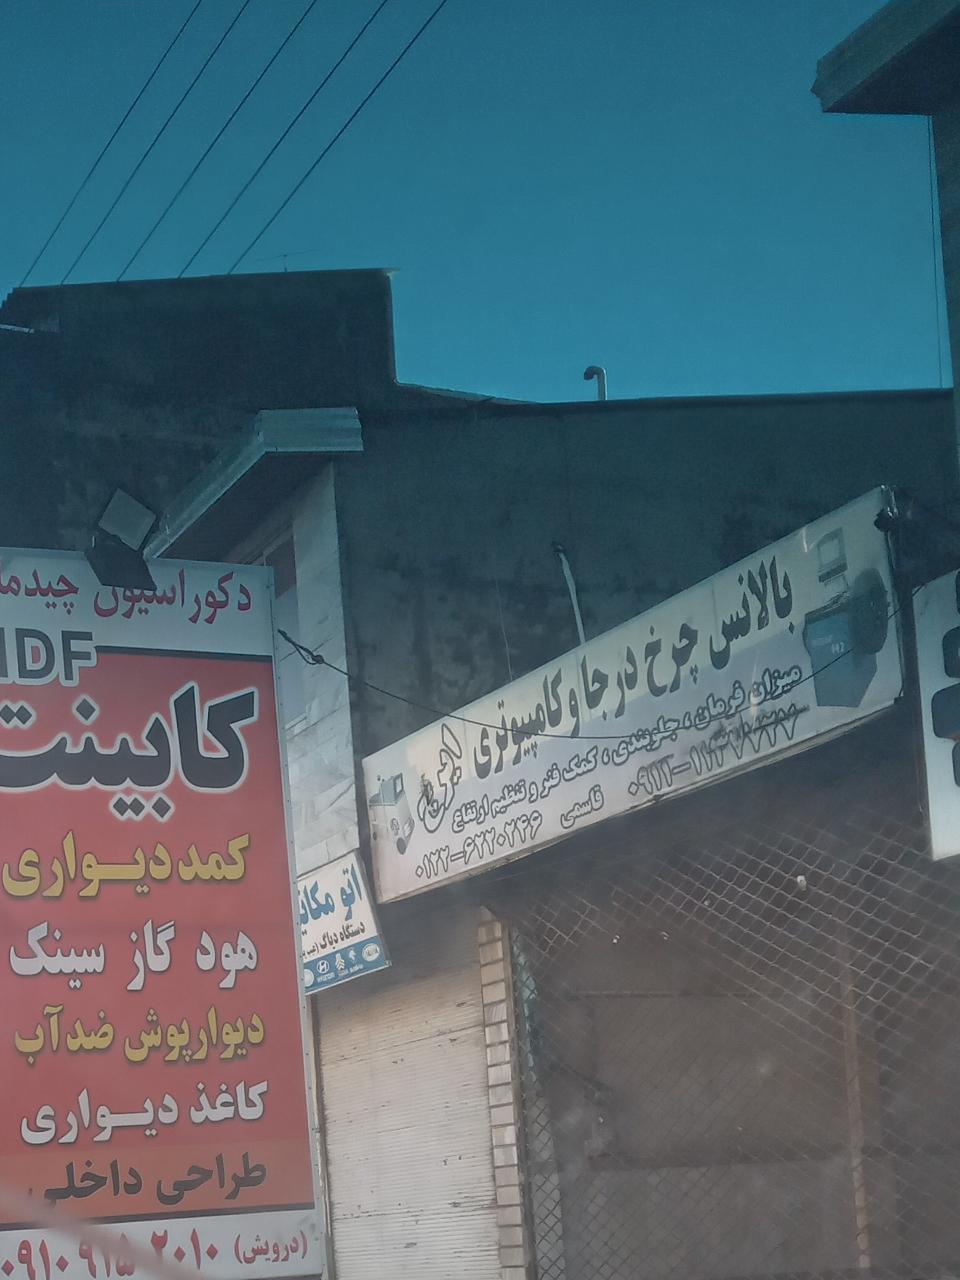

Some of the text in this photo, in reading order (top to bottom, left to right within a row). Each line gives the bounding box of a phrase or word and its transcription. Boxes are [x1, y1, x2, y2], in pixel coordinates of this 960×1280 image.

[709, 555, 795, 670] بالانس
[644, 614, 700, 697] چرخ
[540, 763, 562, 799] فنر
[562, 746, 598, 781] کمک
[561, 784, 604, 829] قاسمی
[1, 830, 252, 898] کمد دیواری
[8, 919, 259, 991] هود گاز سینک
[124, 1005, 265, 1063] دیوارپوش
[20, 1080, 269, 1146] کاغذ دیواری
[156, 1152, 267, 1205] طراحی
